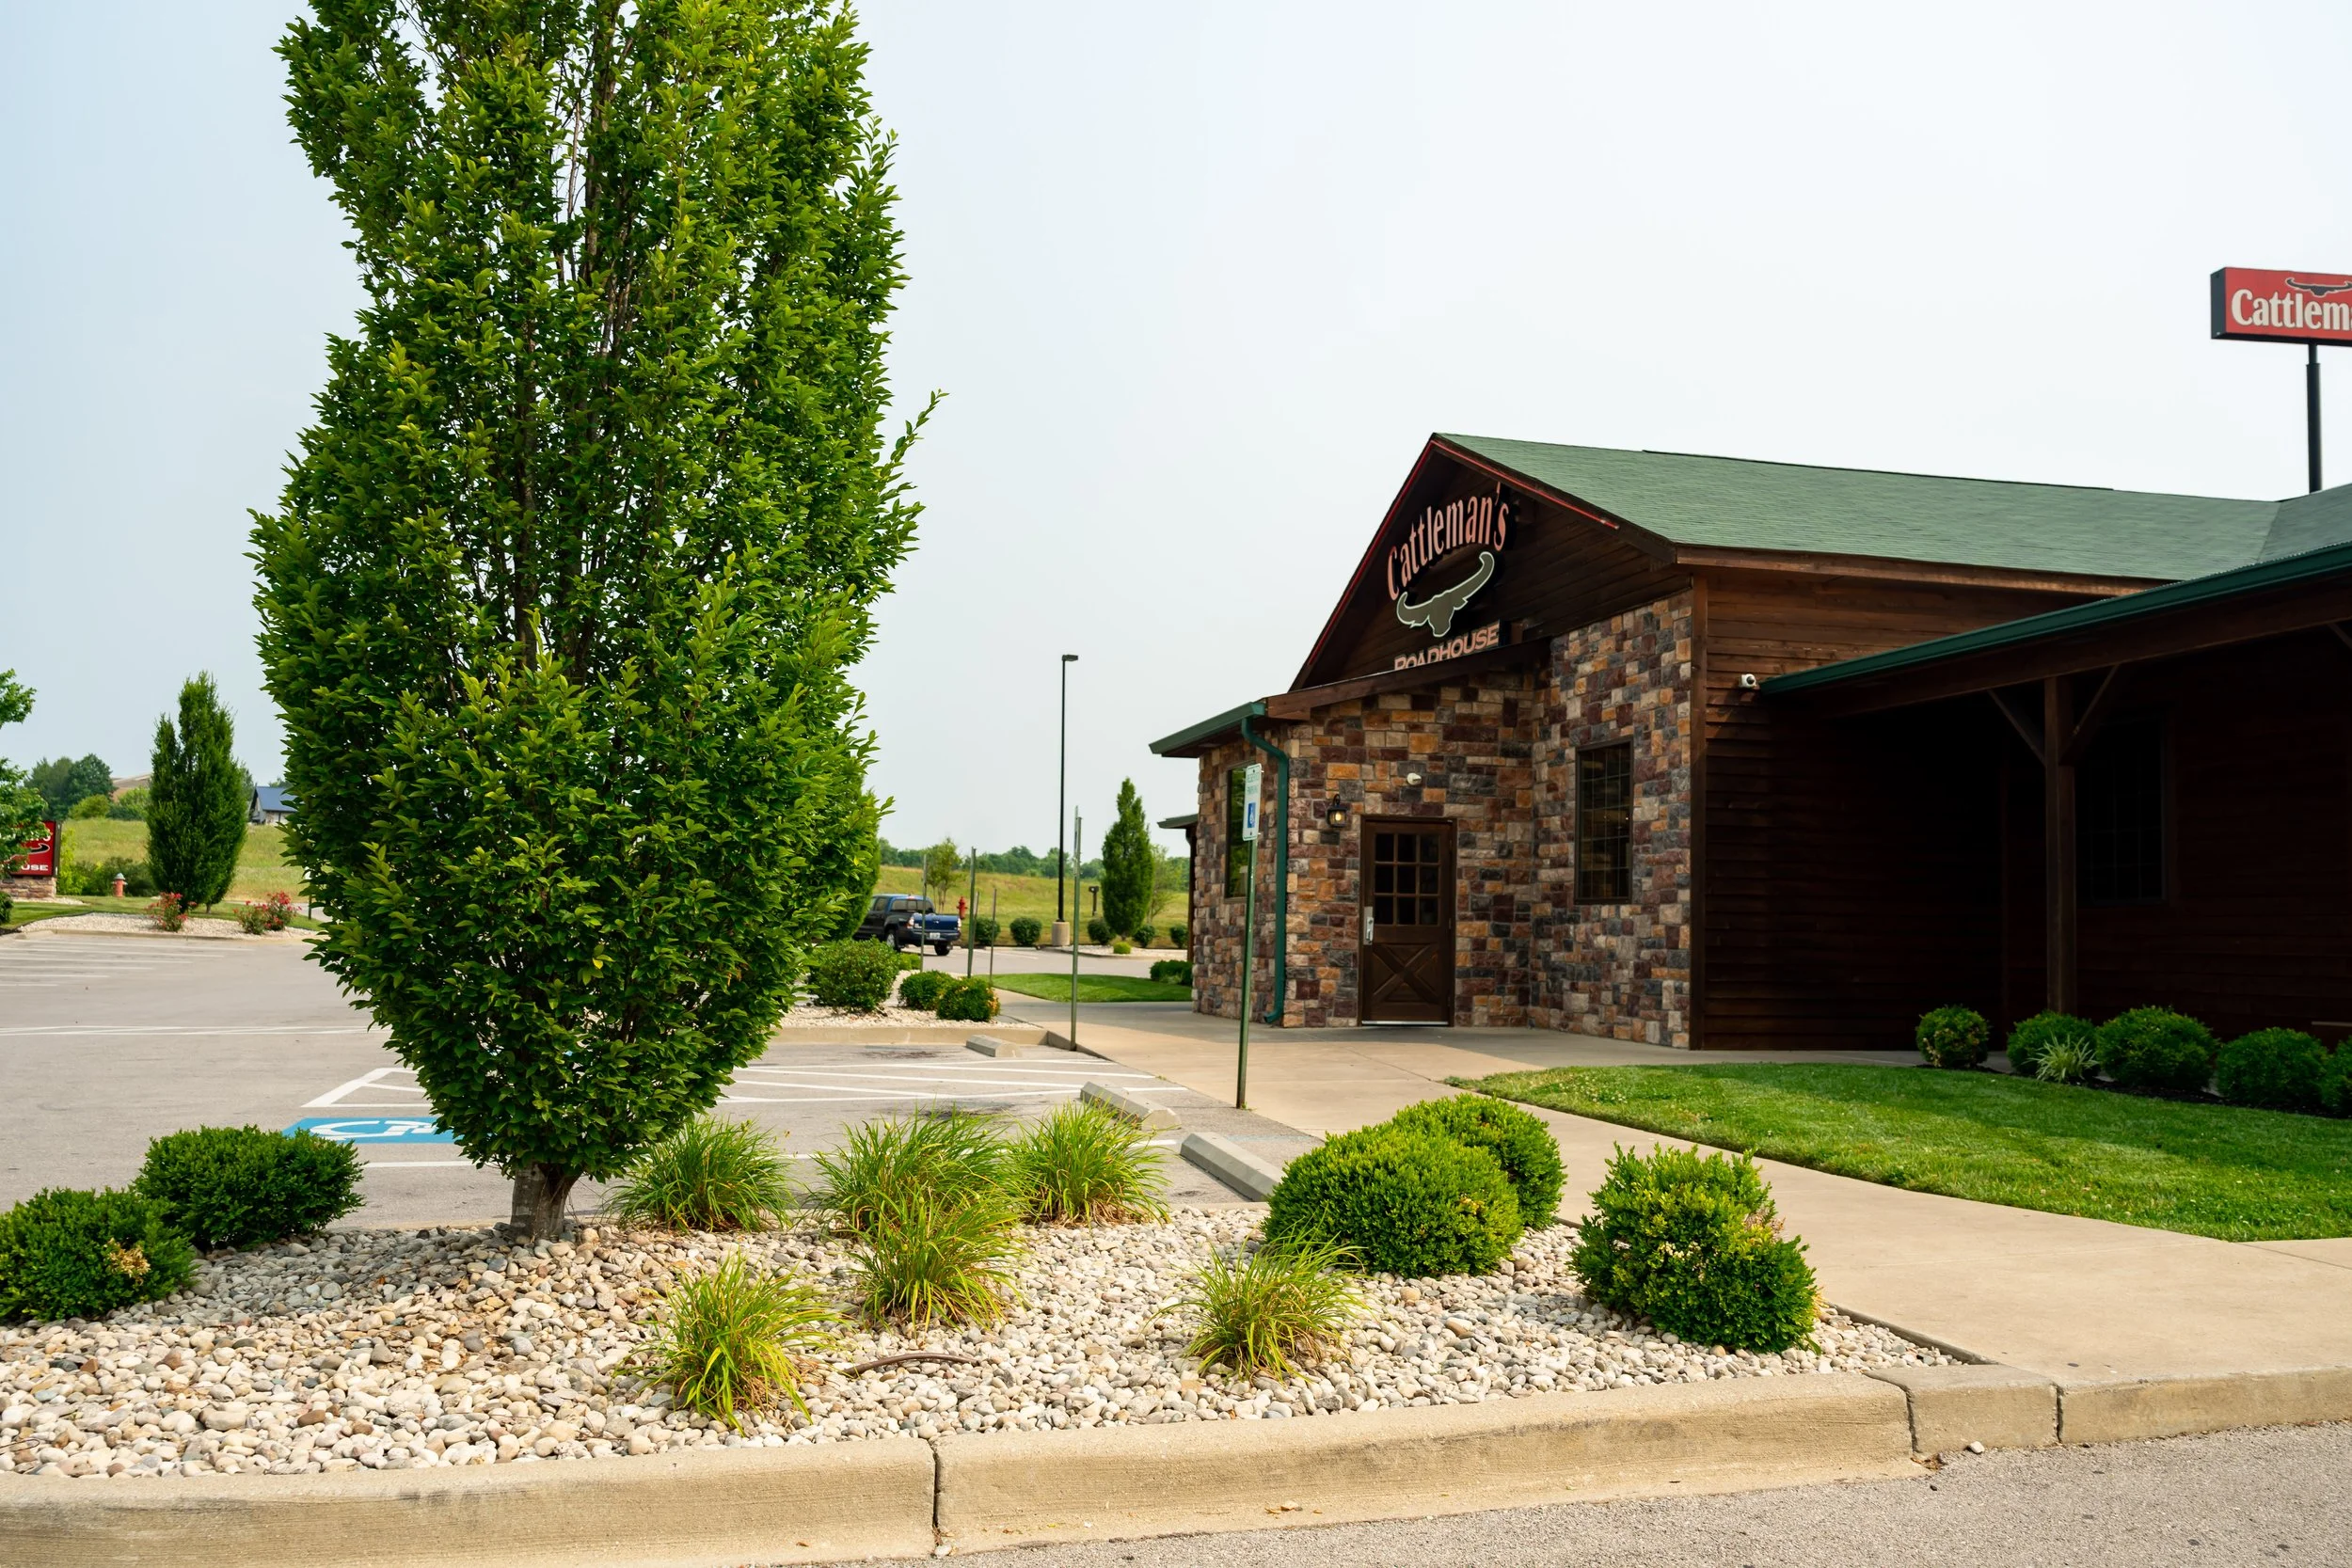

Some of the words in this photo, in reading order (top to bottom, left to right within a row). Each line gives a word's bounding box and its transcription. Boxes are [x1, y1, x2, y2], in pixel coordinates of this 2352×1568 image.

[2231, 288, 2352, 331] Cattlem
[1388, 482, 1509, 600] Cattleman's
[1394, 622, 1500, 671] ROADHOUSE
